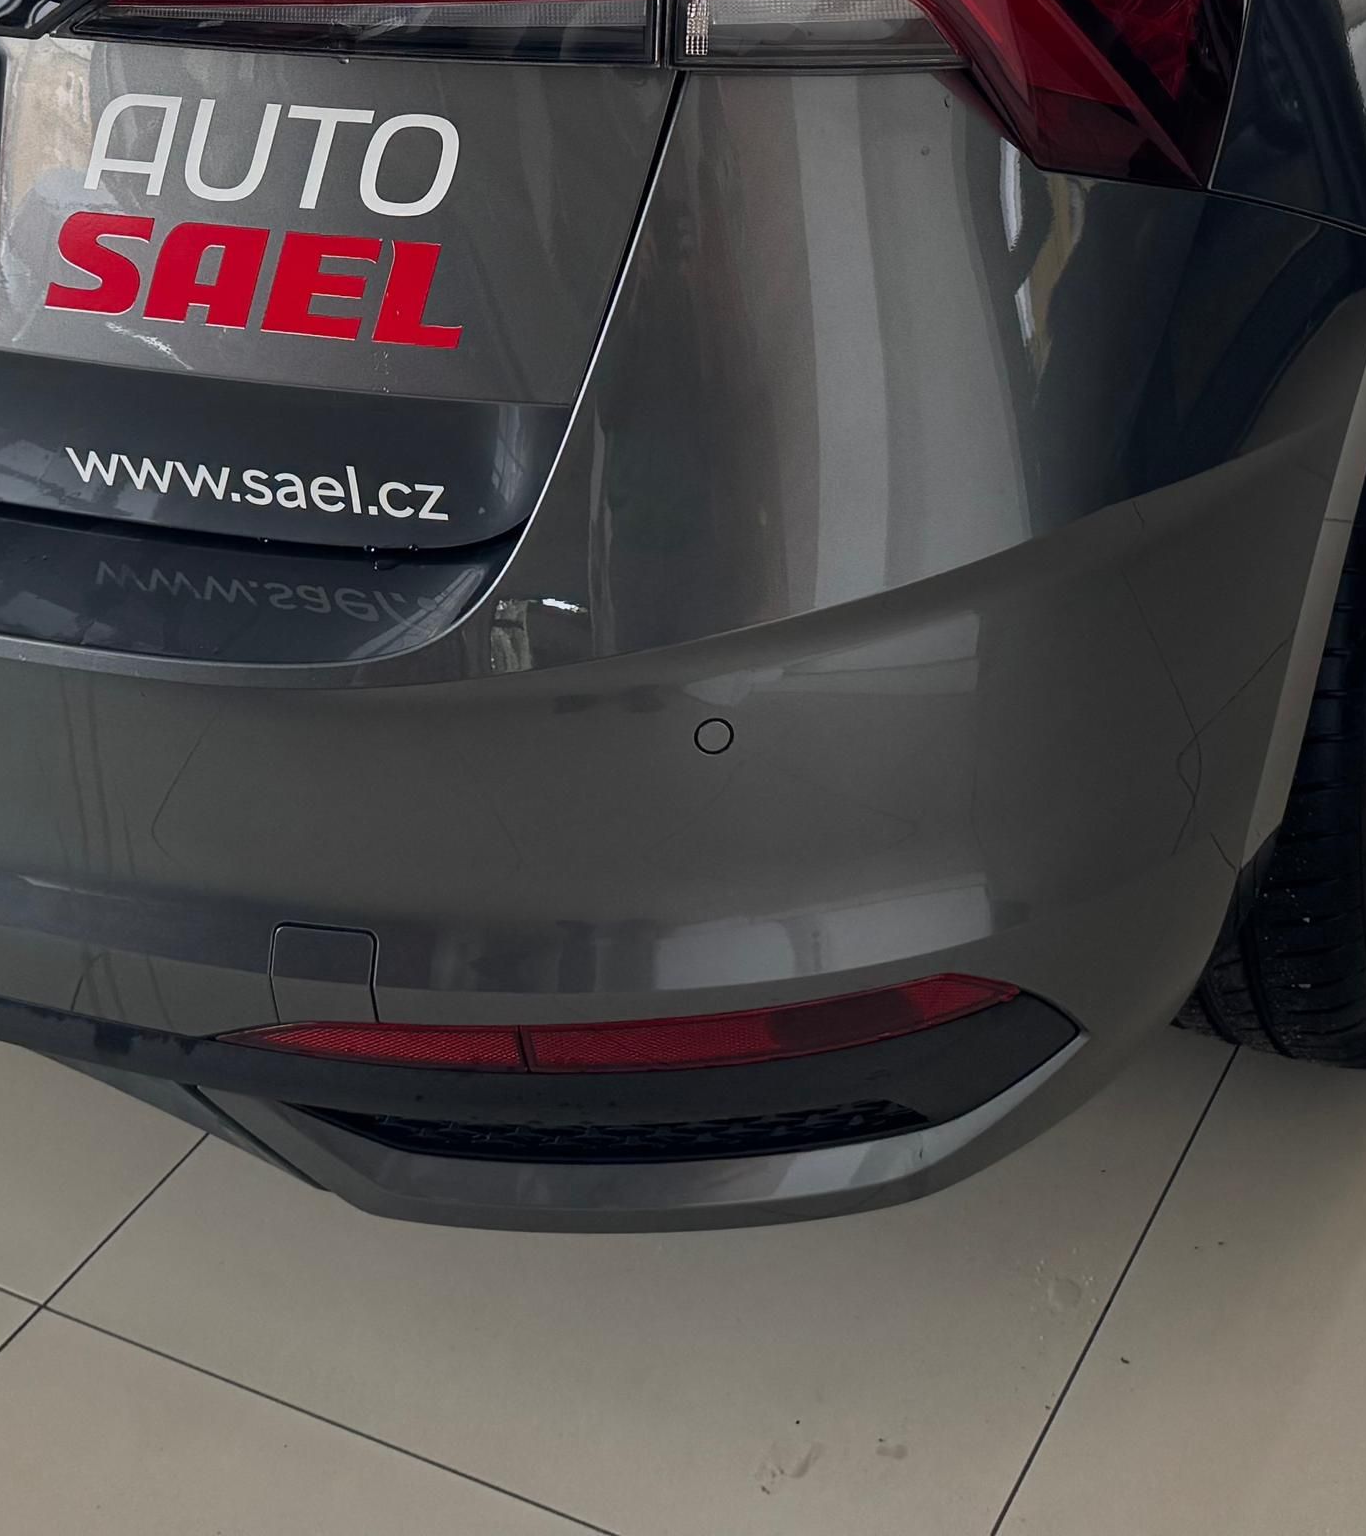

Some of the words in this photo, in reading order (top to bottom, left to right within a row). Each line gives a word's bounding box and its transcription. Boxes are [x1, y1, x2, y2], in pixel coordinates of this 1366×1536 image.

[83, 93, 461, 217] AUTO
[44, 211, 464, 349] SAEL
[65, 445, 450, 522] www.sael.cz
